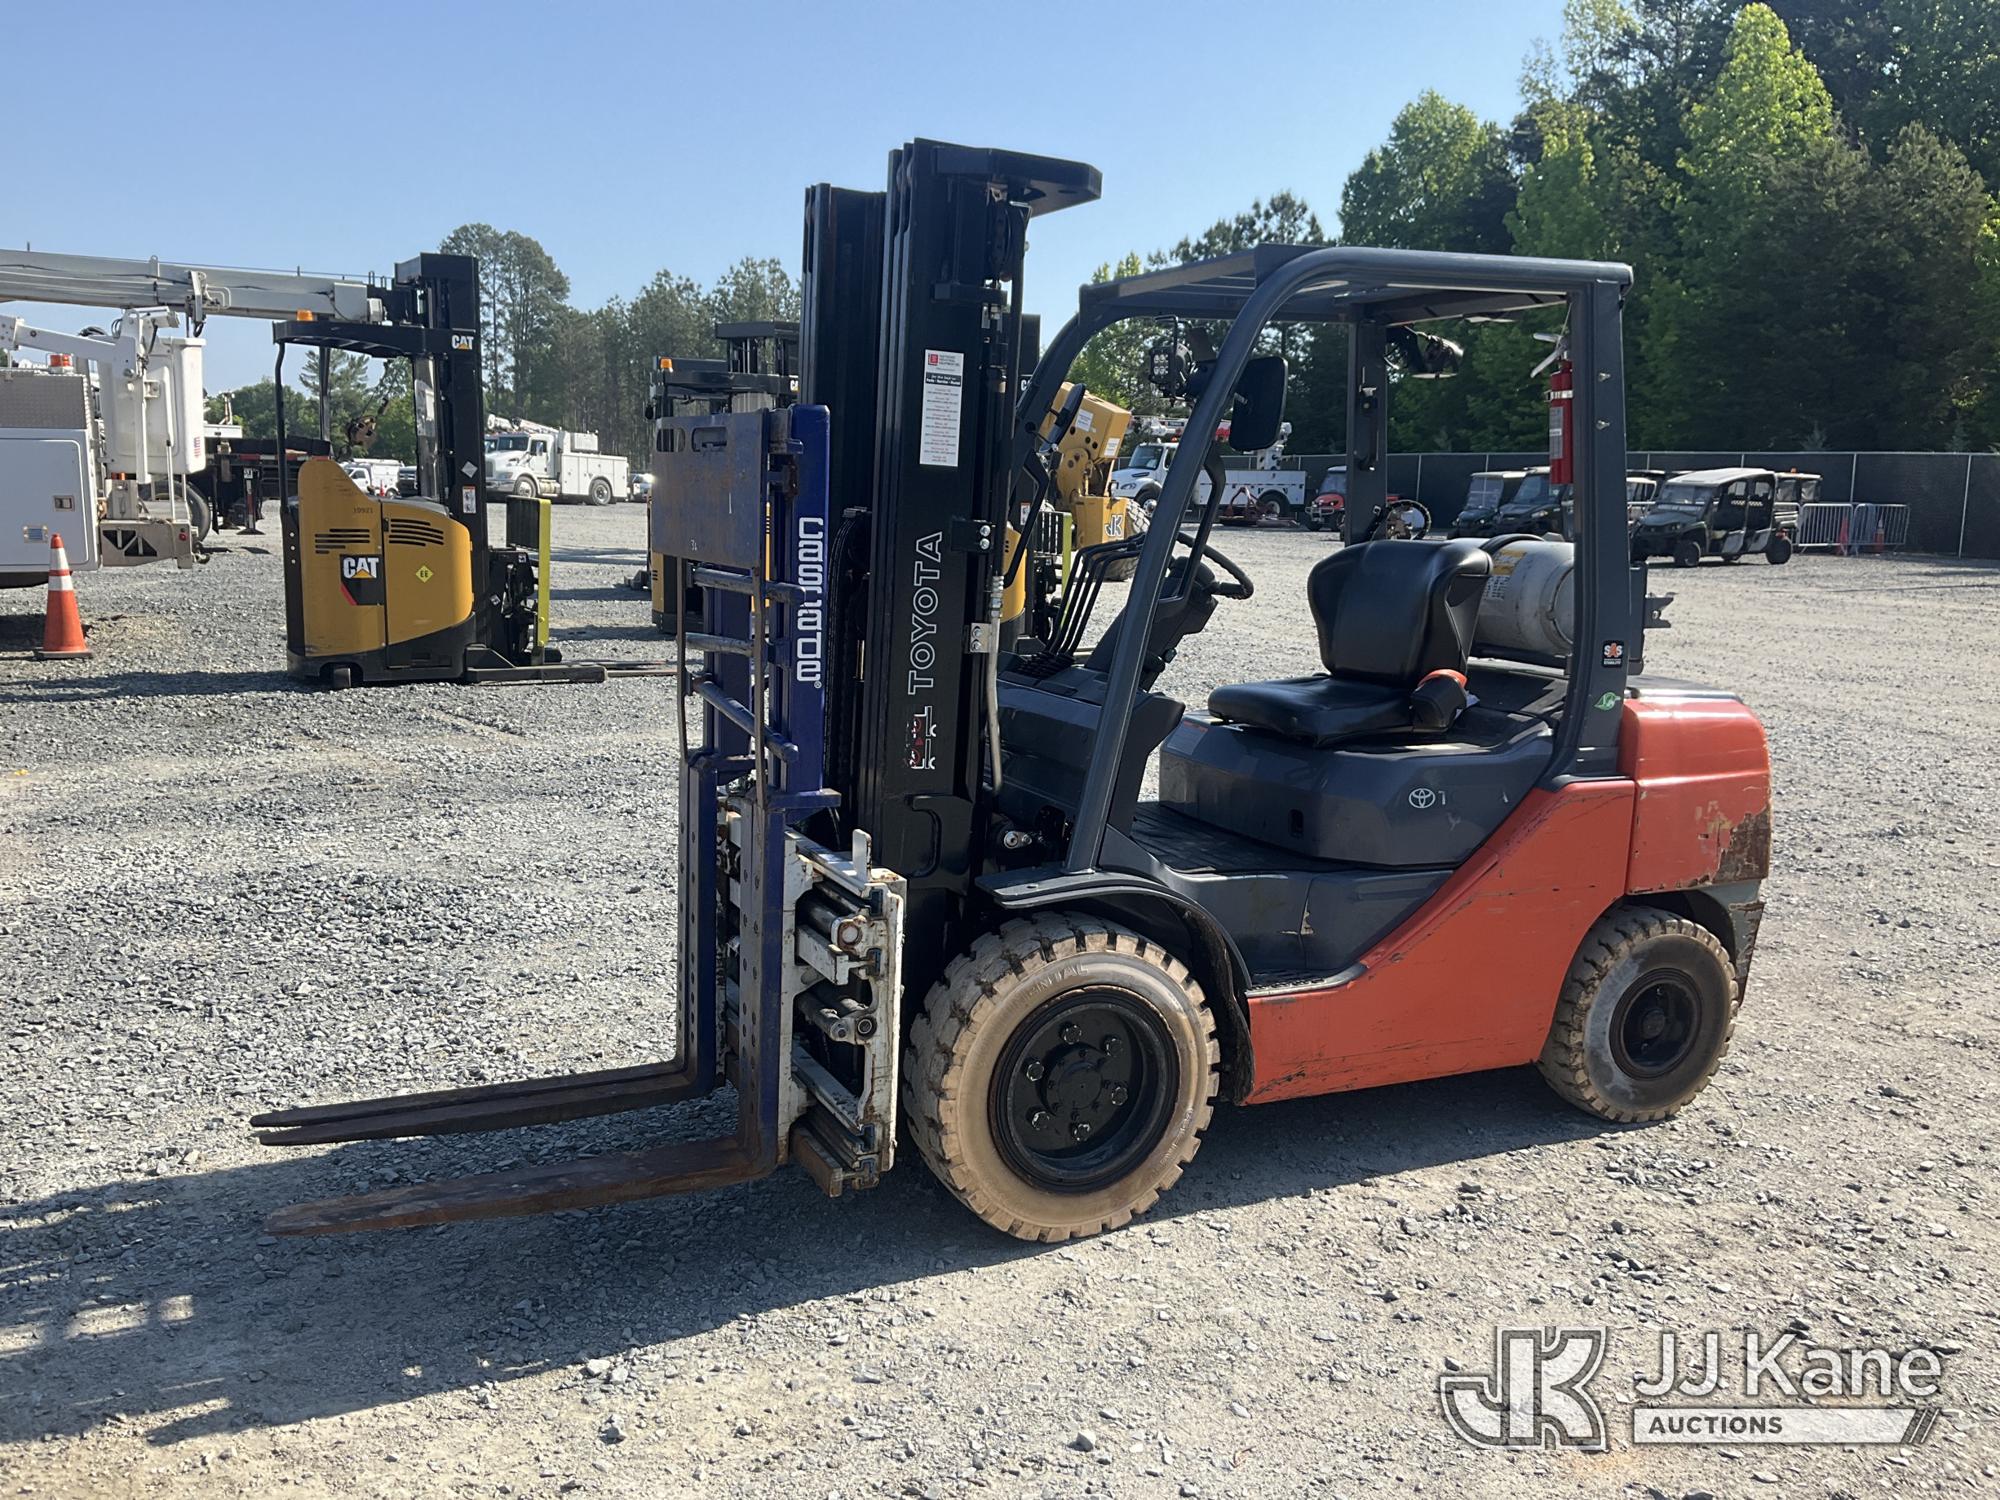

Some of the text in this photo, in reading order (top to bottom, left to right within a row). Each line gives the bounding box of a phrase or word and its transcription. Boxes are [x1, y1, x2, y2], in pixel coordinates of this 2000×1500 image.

[452, 335, 474, 350] CAT
[343, 557, 379, 579] CAT
[420, 570, 428, 578] EE
[908, 531, 943, 695] TOYOTA
[1604, 643, 1622, 657] SAS
